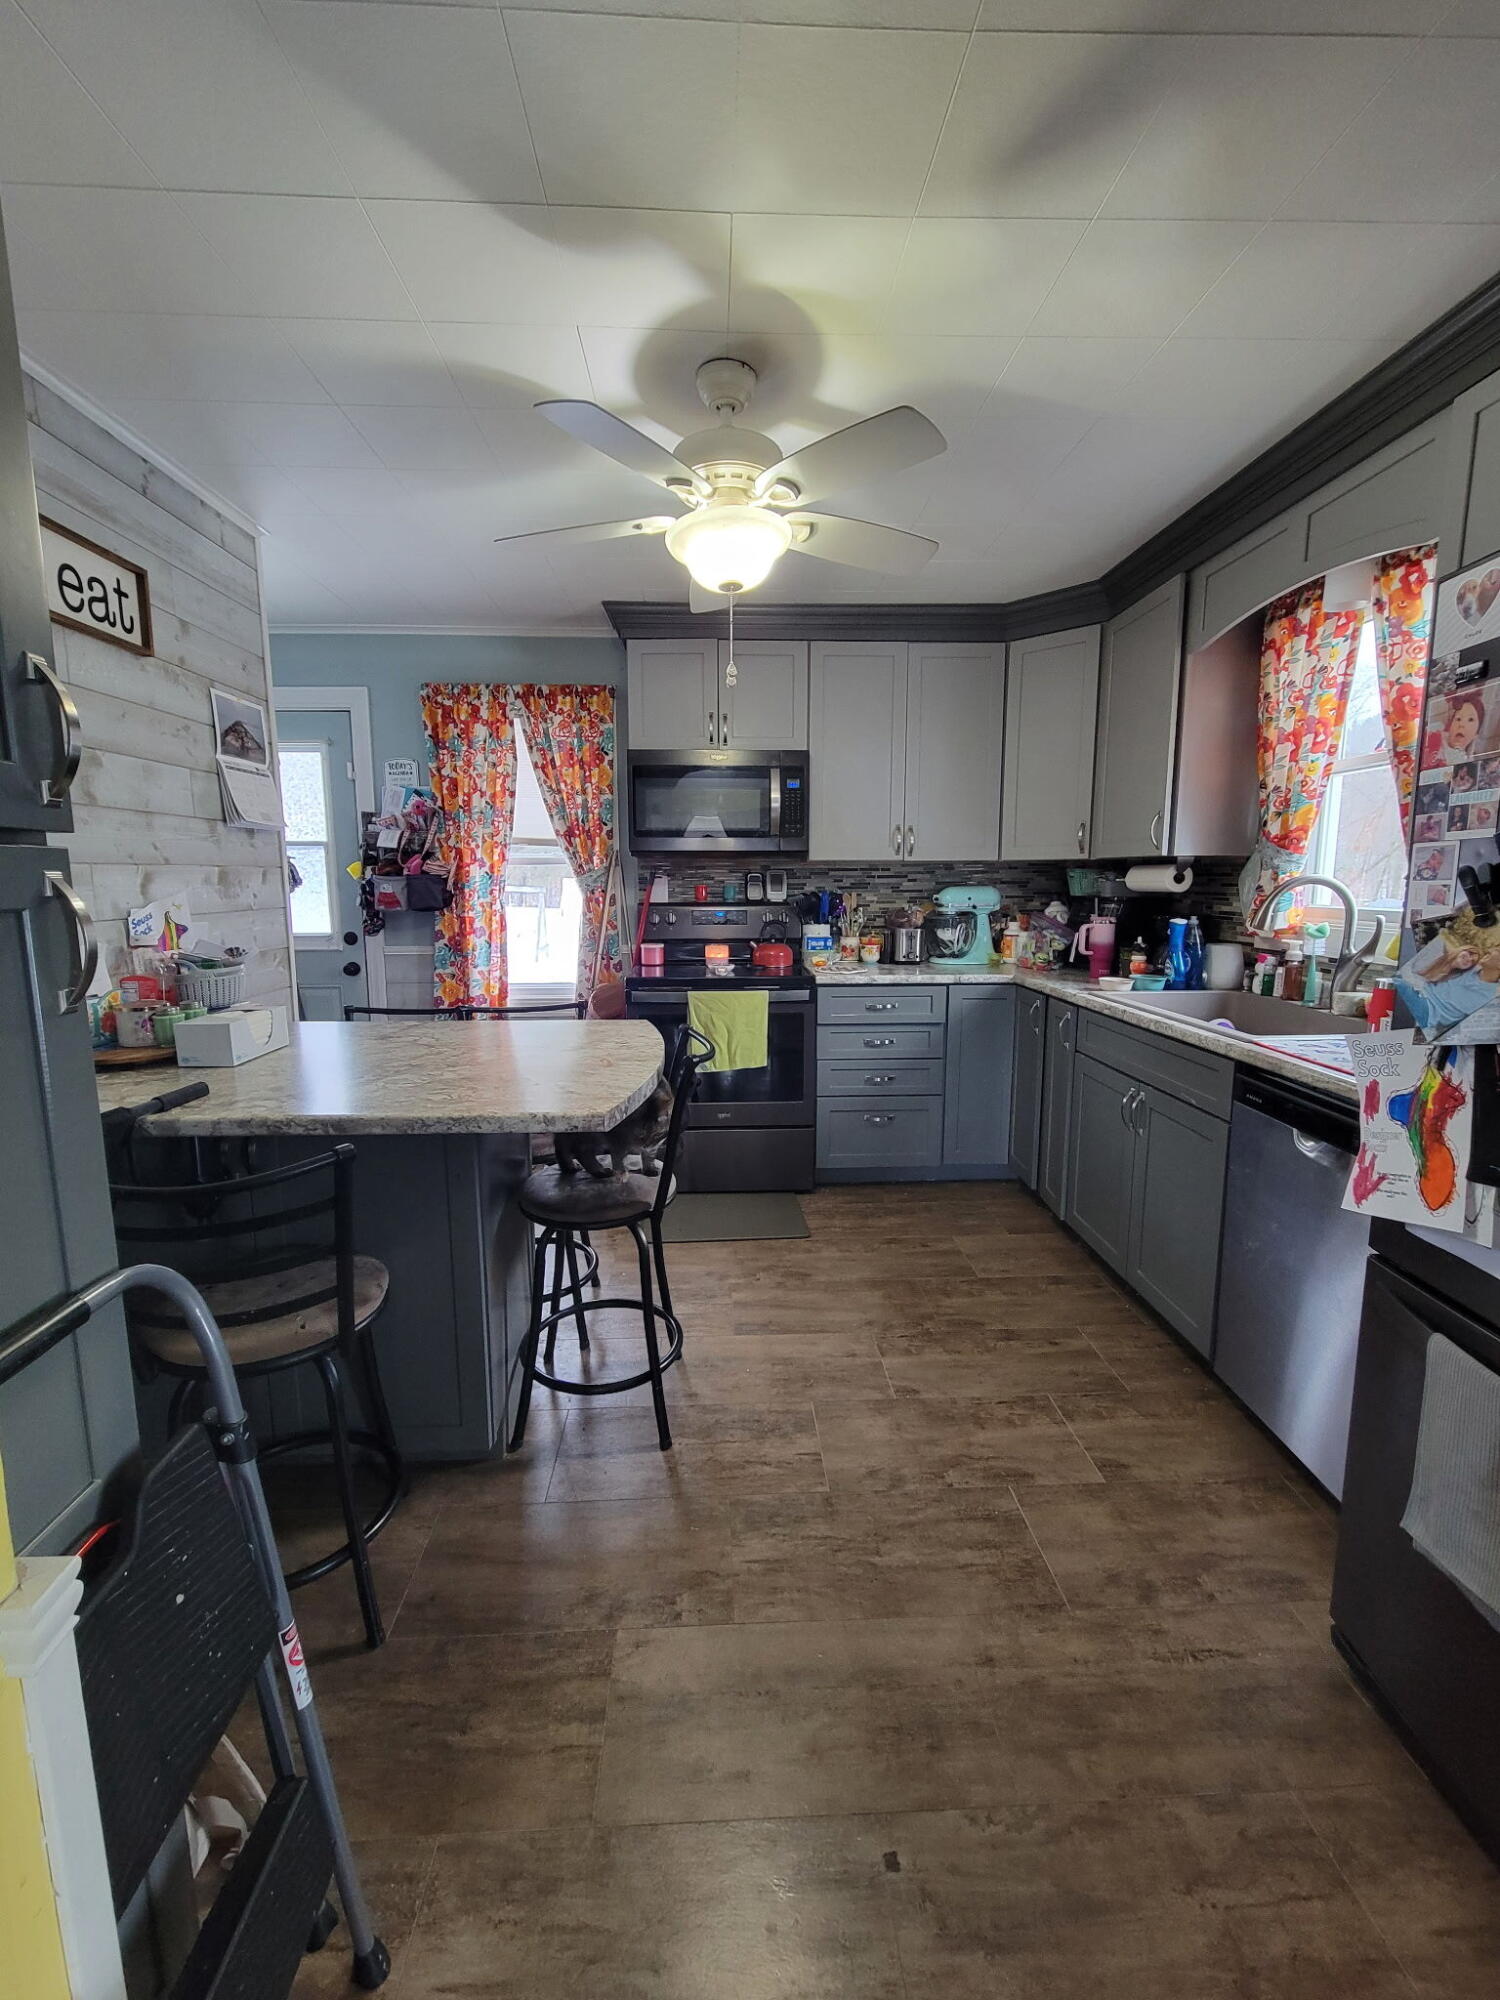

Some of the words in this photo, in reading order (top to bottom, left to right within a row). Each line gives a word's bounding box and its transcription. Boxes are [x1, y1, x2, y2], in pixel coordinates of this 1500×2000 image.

[57, 562, 135, 635] eat
[132, 912, 153, 930] Seuss
[1352, 1039, 1405, 1059] Seuss
[1357, 1056, 1401, 1078] Sock
